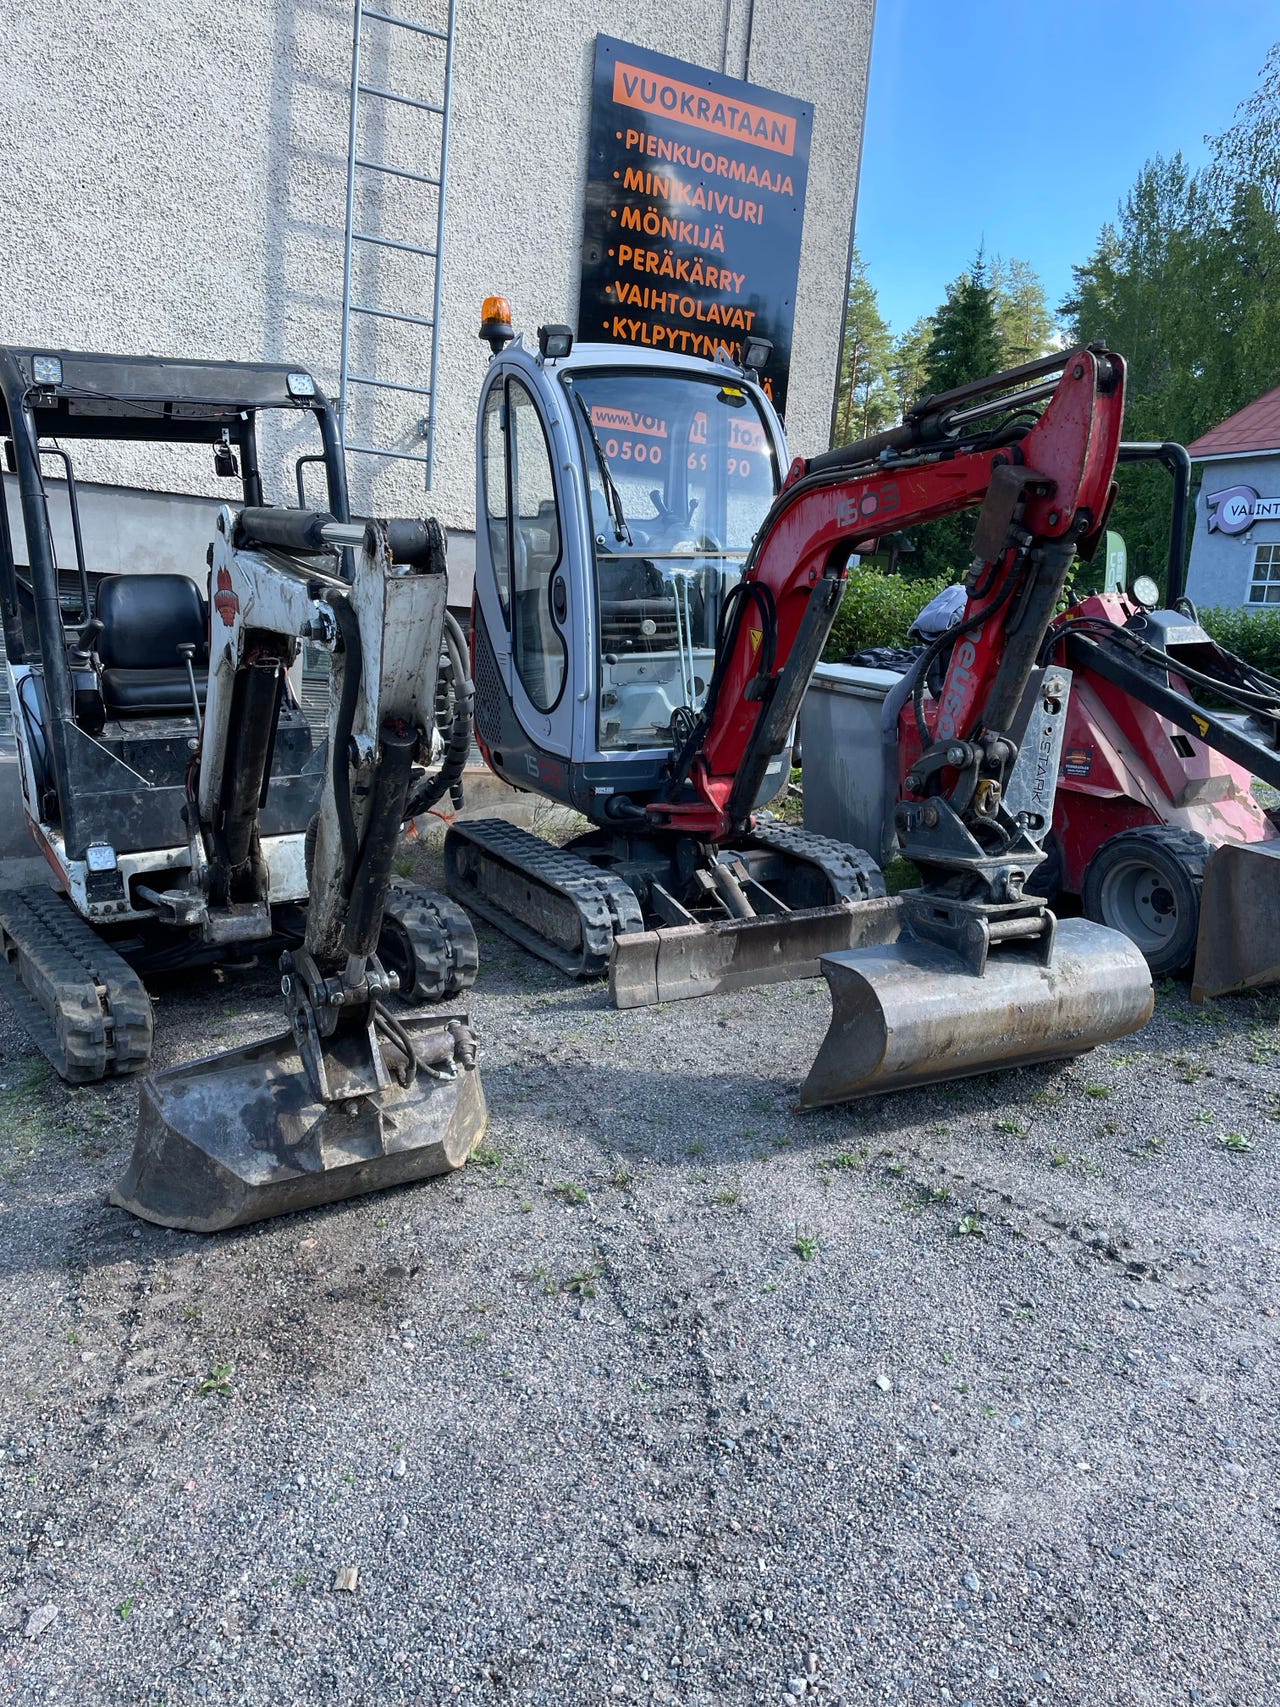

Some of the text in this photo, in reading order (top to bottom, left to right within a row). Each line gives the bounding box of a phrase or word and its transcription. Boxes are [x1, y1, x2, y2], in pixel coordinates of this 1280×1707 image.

[622, 72, 788, 146] VUOKRATAAN
[625, 128, 795, 197] PIENKUORMAAJA
[623, 167, 764, 225] MINIKAIVURI
[620, 206, 725, 253] MÖNKIJÄ
[618, 248, 746, 294] PERÄKÄRRY
[615, 280, 756, 331] VAIHTOLAVAT
[835, 482, 899, 528] 1503
[1031, 740, 1052, 803] STARK
